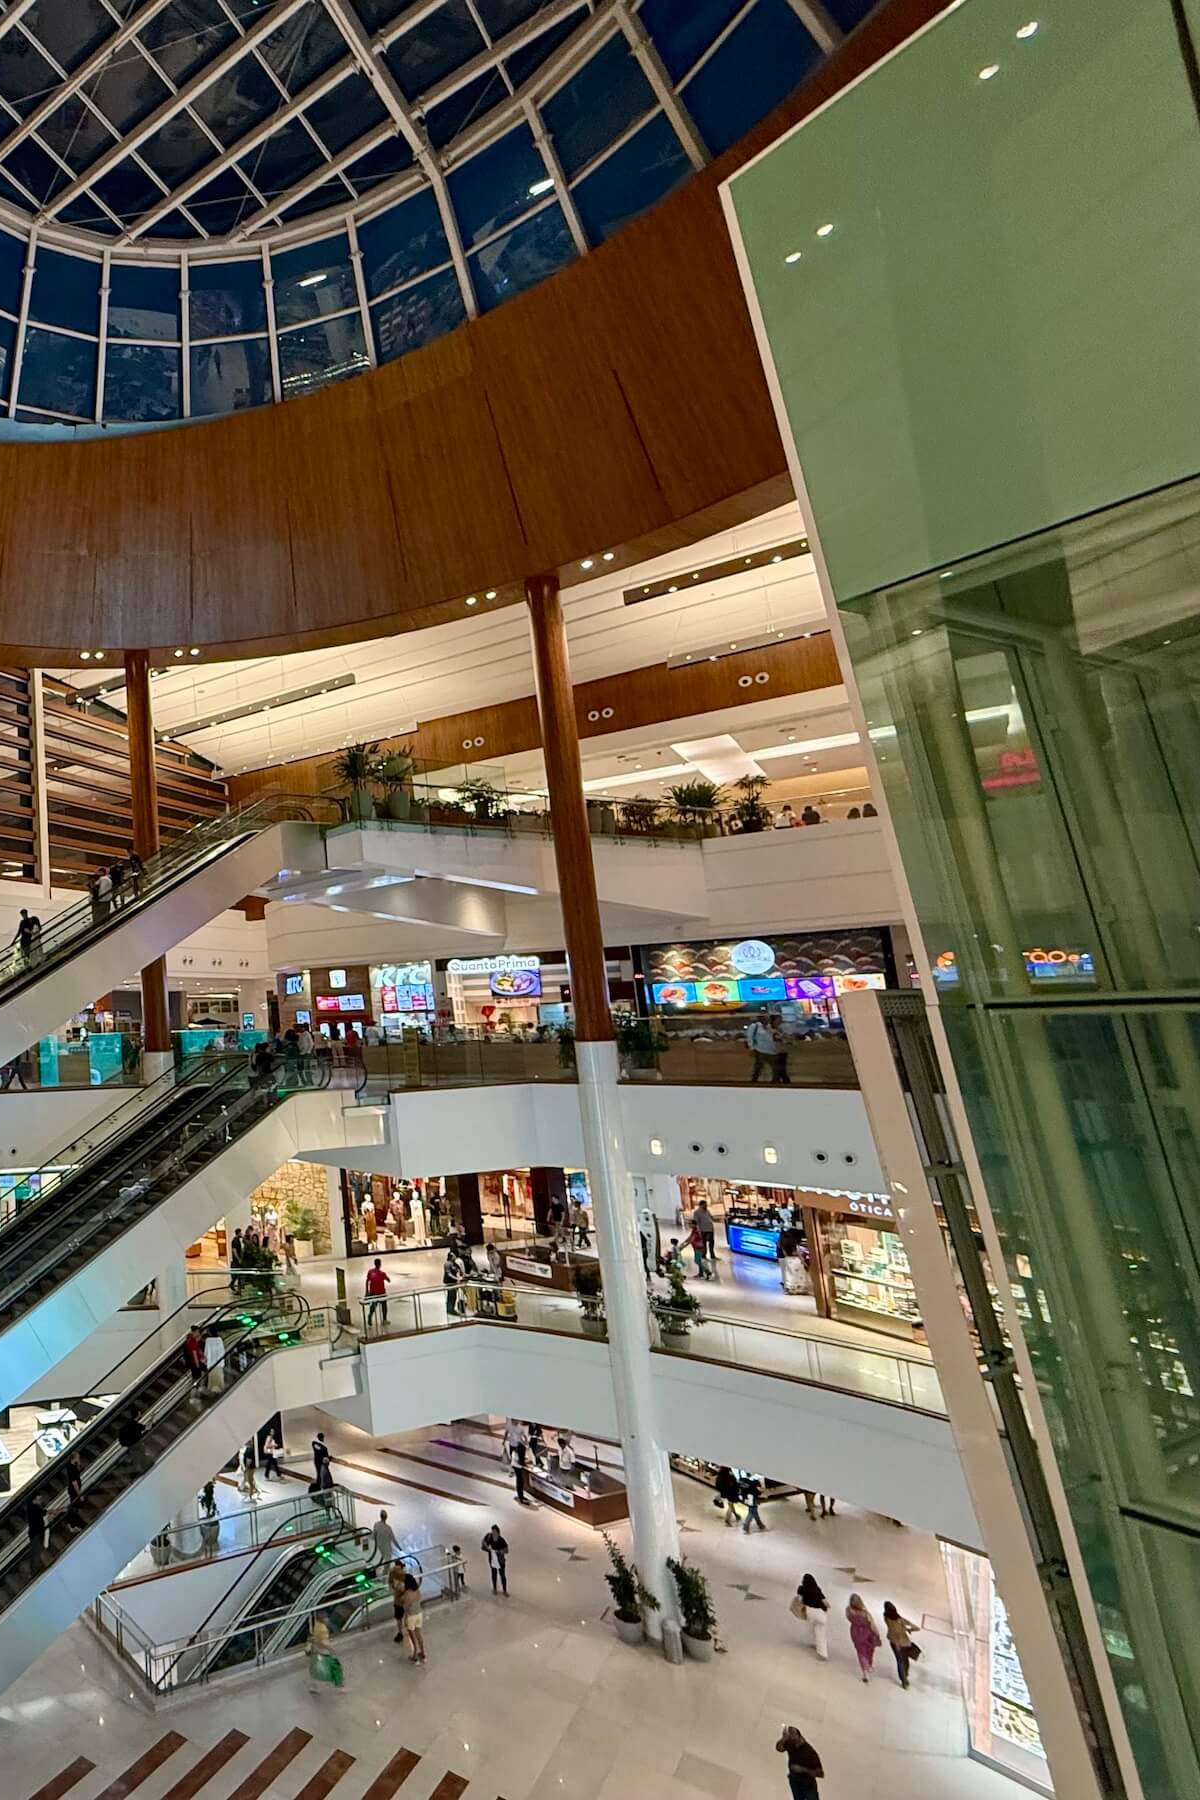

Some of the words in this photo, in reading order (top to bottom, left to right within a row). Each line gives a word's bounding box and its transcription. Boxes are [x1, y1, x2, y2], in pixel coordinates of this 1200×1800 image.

[449, 957, 537, 972] QuantoPrima
[286, 975, 303, 994] KFC
[374, 965, 427, 988] KFC
